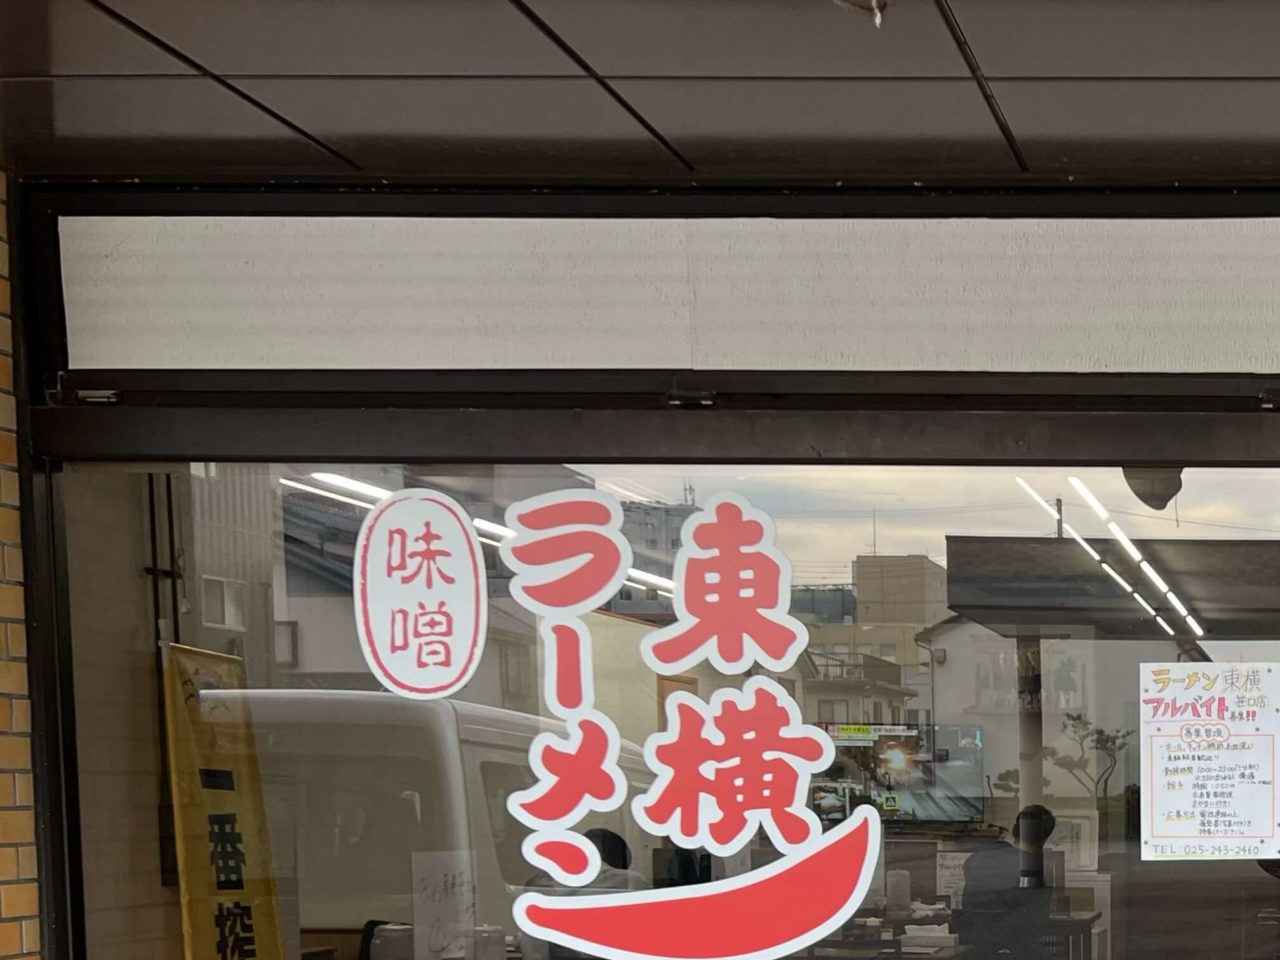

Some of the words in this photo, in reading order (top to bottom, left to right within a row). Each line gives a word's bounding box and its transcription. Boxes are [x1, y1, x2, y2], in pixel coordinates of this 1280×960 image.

[386, 521, 455, 669] 味噌
[644, 502, 823, 849] 東横
[1142, 696, 1229, 720] アルバイト
[1184, 845, 1260, 855] 025-243-2460
